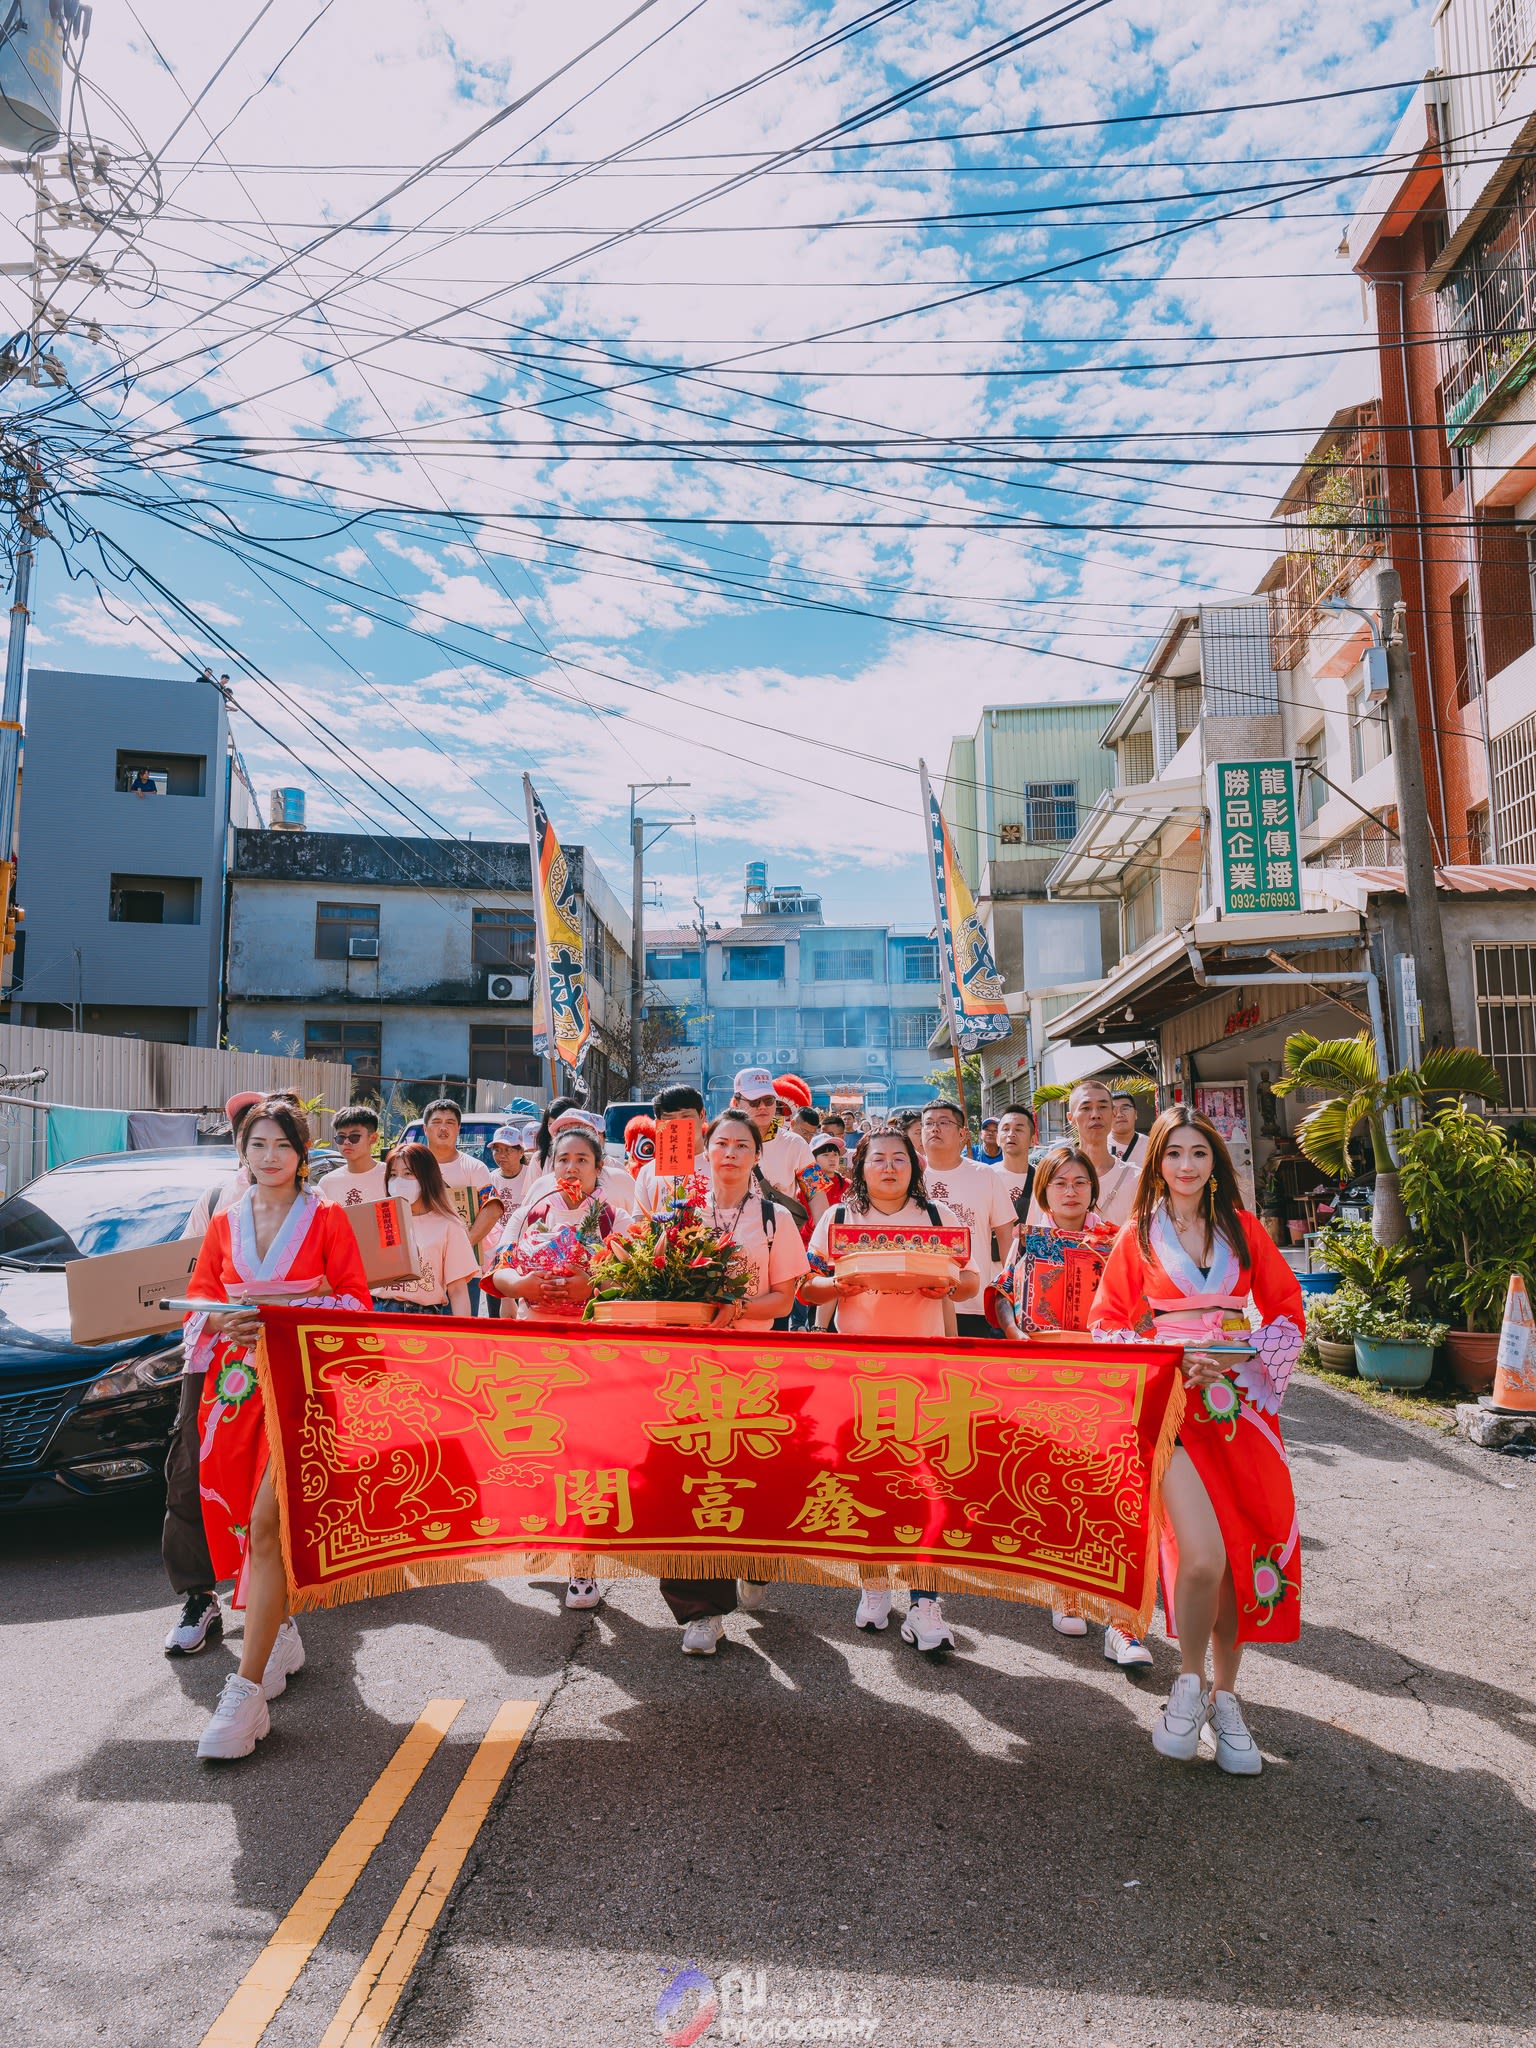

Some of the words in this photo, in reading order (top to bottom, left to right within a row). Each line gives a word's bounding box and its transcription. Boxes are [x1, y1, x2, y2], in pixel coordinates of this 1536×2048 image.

[1224, 769, 1257, 891] 勝品企業
[1259, 768, 1293, 890] 龍影傳播
[1230, 892, 1297, 910] 0932-676993
[450, 1348, 1001, 1477] 財樂宮
[555, 1468, 886, 1539] 鑫富閣
